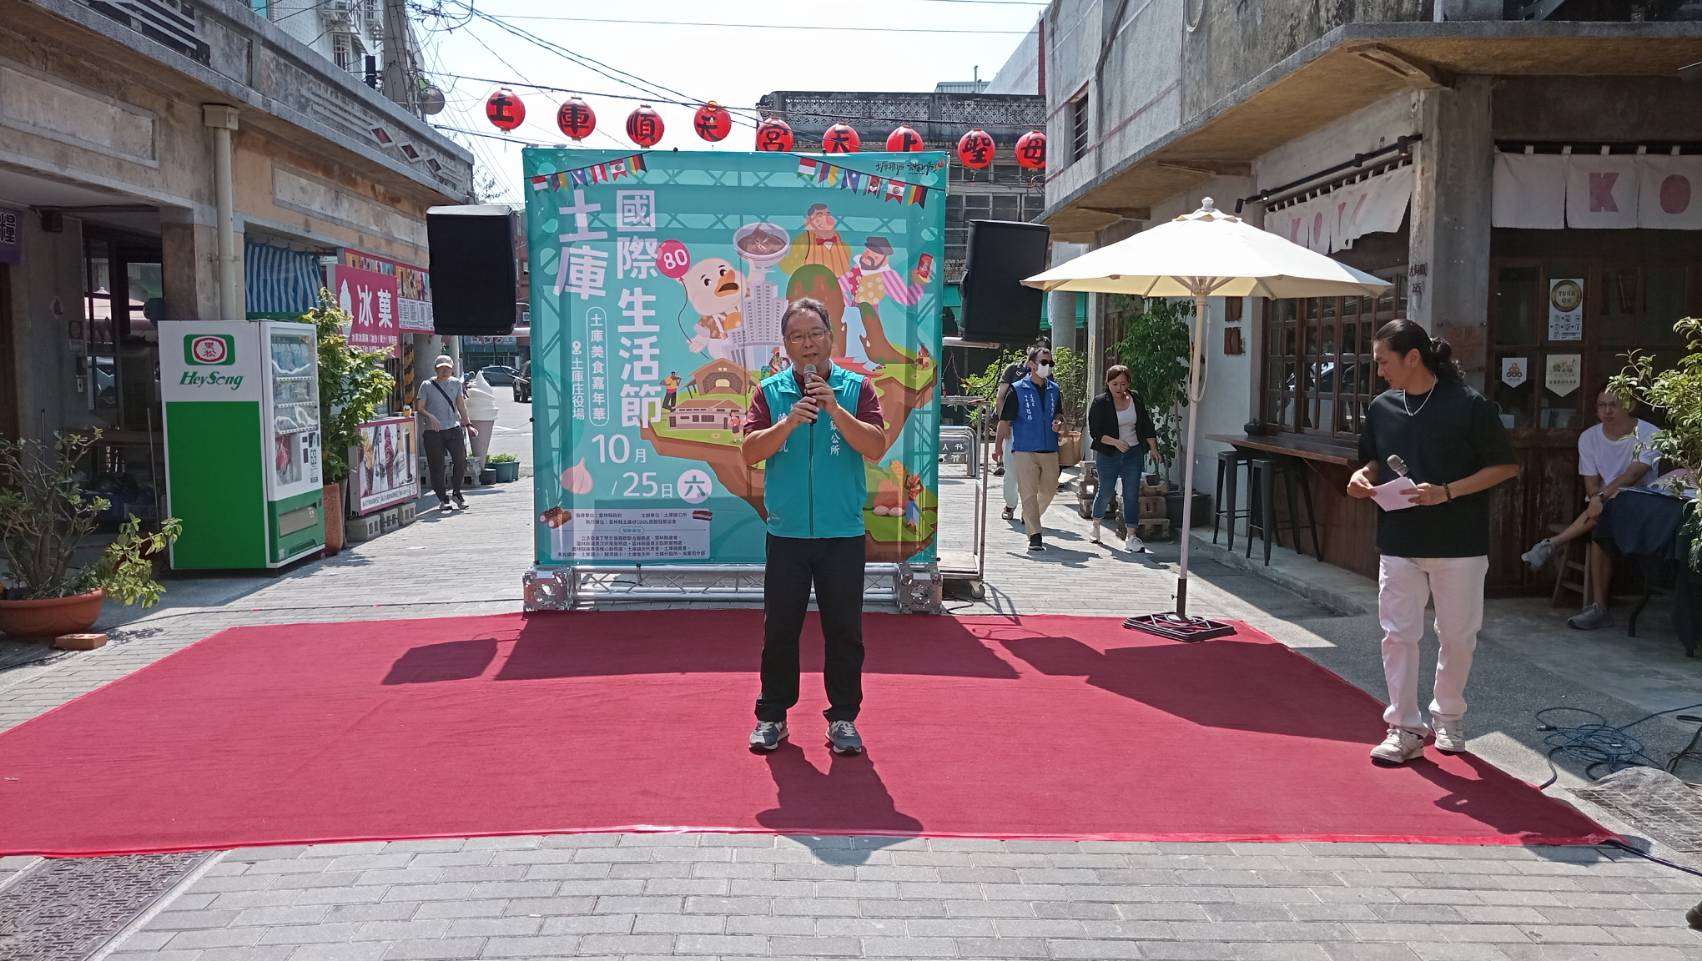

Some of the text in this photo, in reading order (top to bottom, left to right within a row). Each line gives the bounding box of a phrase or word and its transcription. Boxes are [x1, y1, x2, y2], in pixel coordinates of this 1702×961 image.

[552, 189, 609, 300] 土庫
[663, 249, 688, 270] 80
[356, 284, 393, 328] 冰菓
[616, 189, 663, 429] 國際生活節
[684, 474, 707, 497] 六
